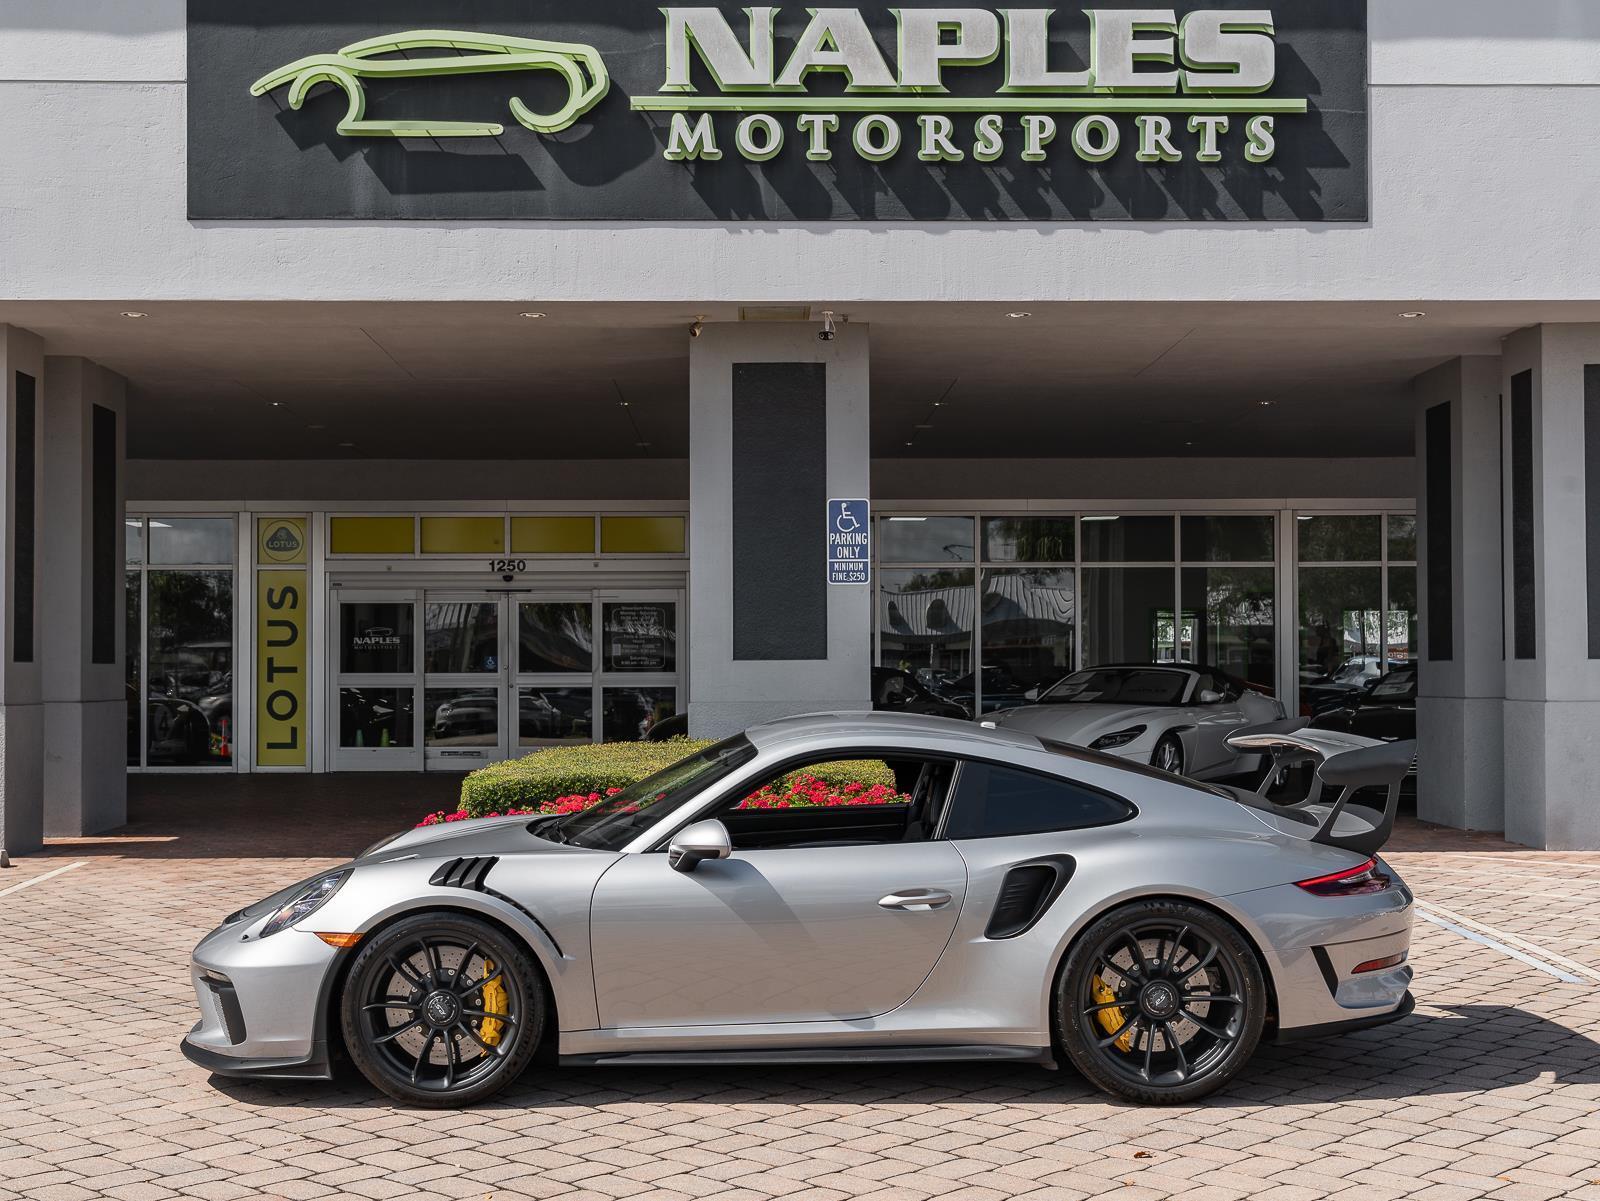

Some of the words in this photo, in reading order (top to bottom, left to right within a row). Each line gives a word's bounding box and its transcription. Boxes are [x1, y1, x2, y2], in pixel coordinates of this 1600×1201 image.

[657, 7, 1275, 94] NAPLES
[664, 113, 1275, 162] MOTORSPORTS
[268, 540, 297, 548] LOTUS
[830, 533, 867, 545] PARKING
[836, 546, 860, 558] ONLY
[489, 559, 526, 572] 1250
[834, 562, 864, 571] MINIMUM
[832, 572, 847, 581] FINE
[849, 571, 866, 581] $250
[353, 636, 401, 644] NAPLES
[266, 585, 299, 750] LOTUS
